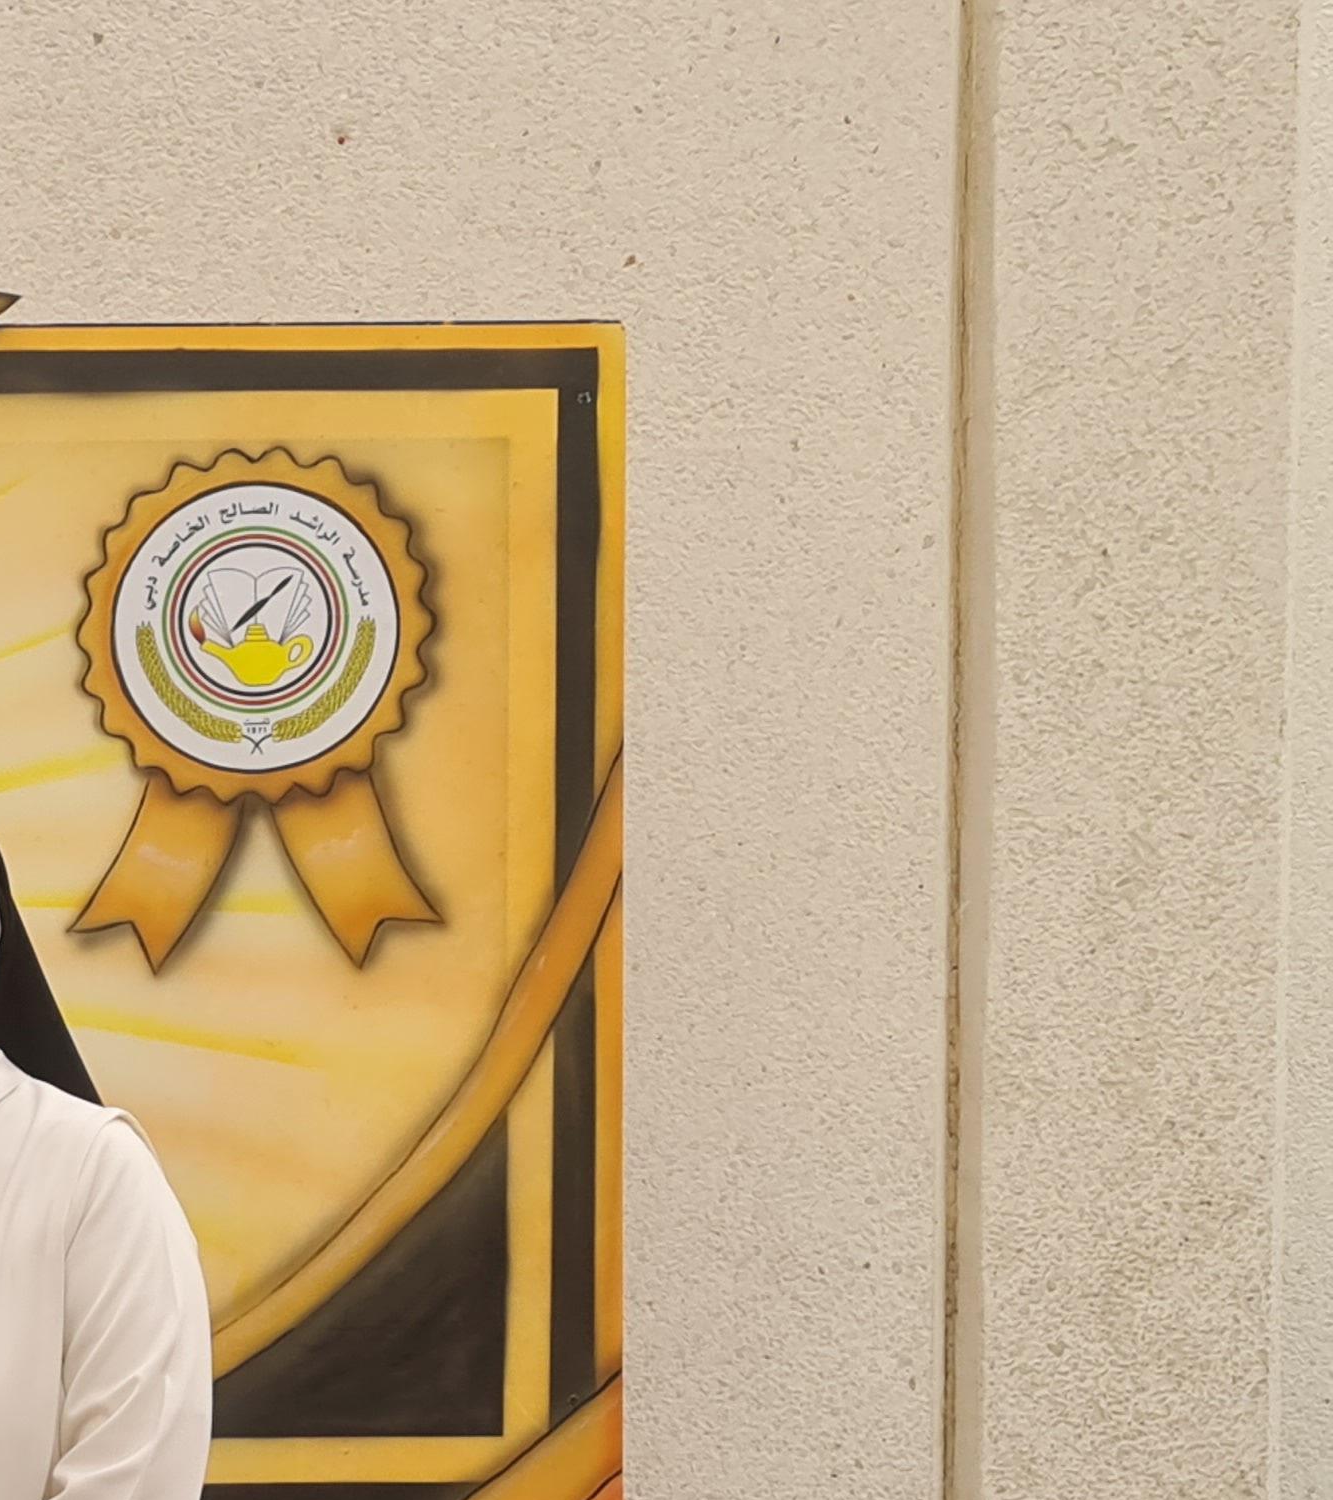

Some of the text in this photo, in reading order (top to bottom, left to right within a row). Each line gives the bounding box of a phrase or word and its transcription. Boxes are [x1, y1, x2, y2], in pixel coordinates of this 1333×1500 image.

[219, 502, 279, 524] الصالح
[289, 511, 341, 546] الراشد
[151, 514, 211, 567] الخاصة
[144, 576, 159, 611] دبي
